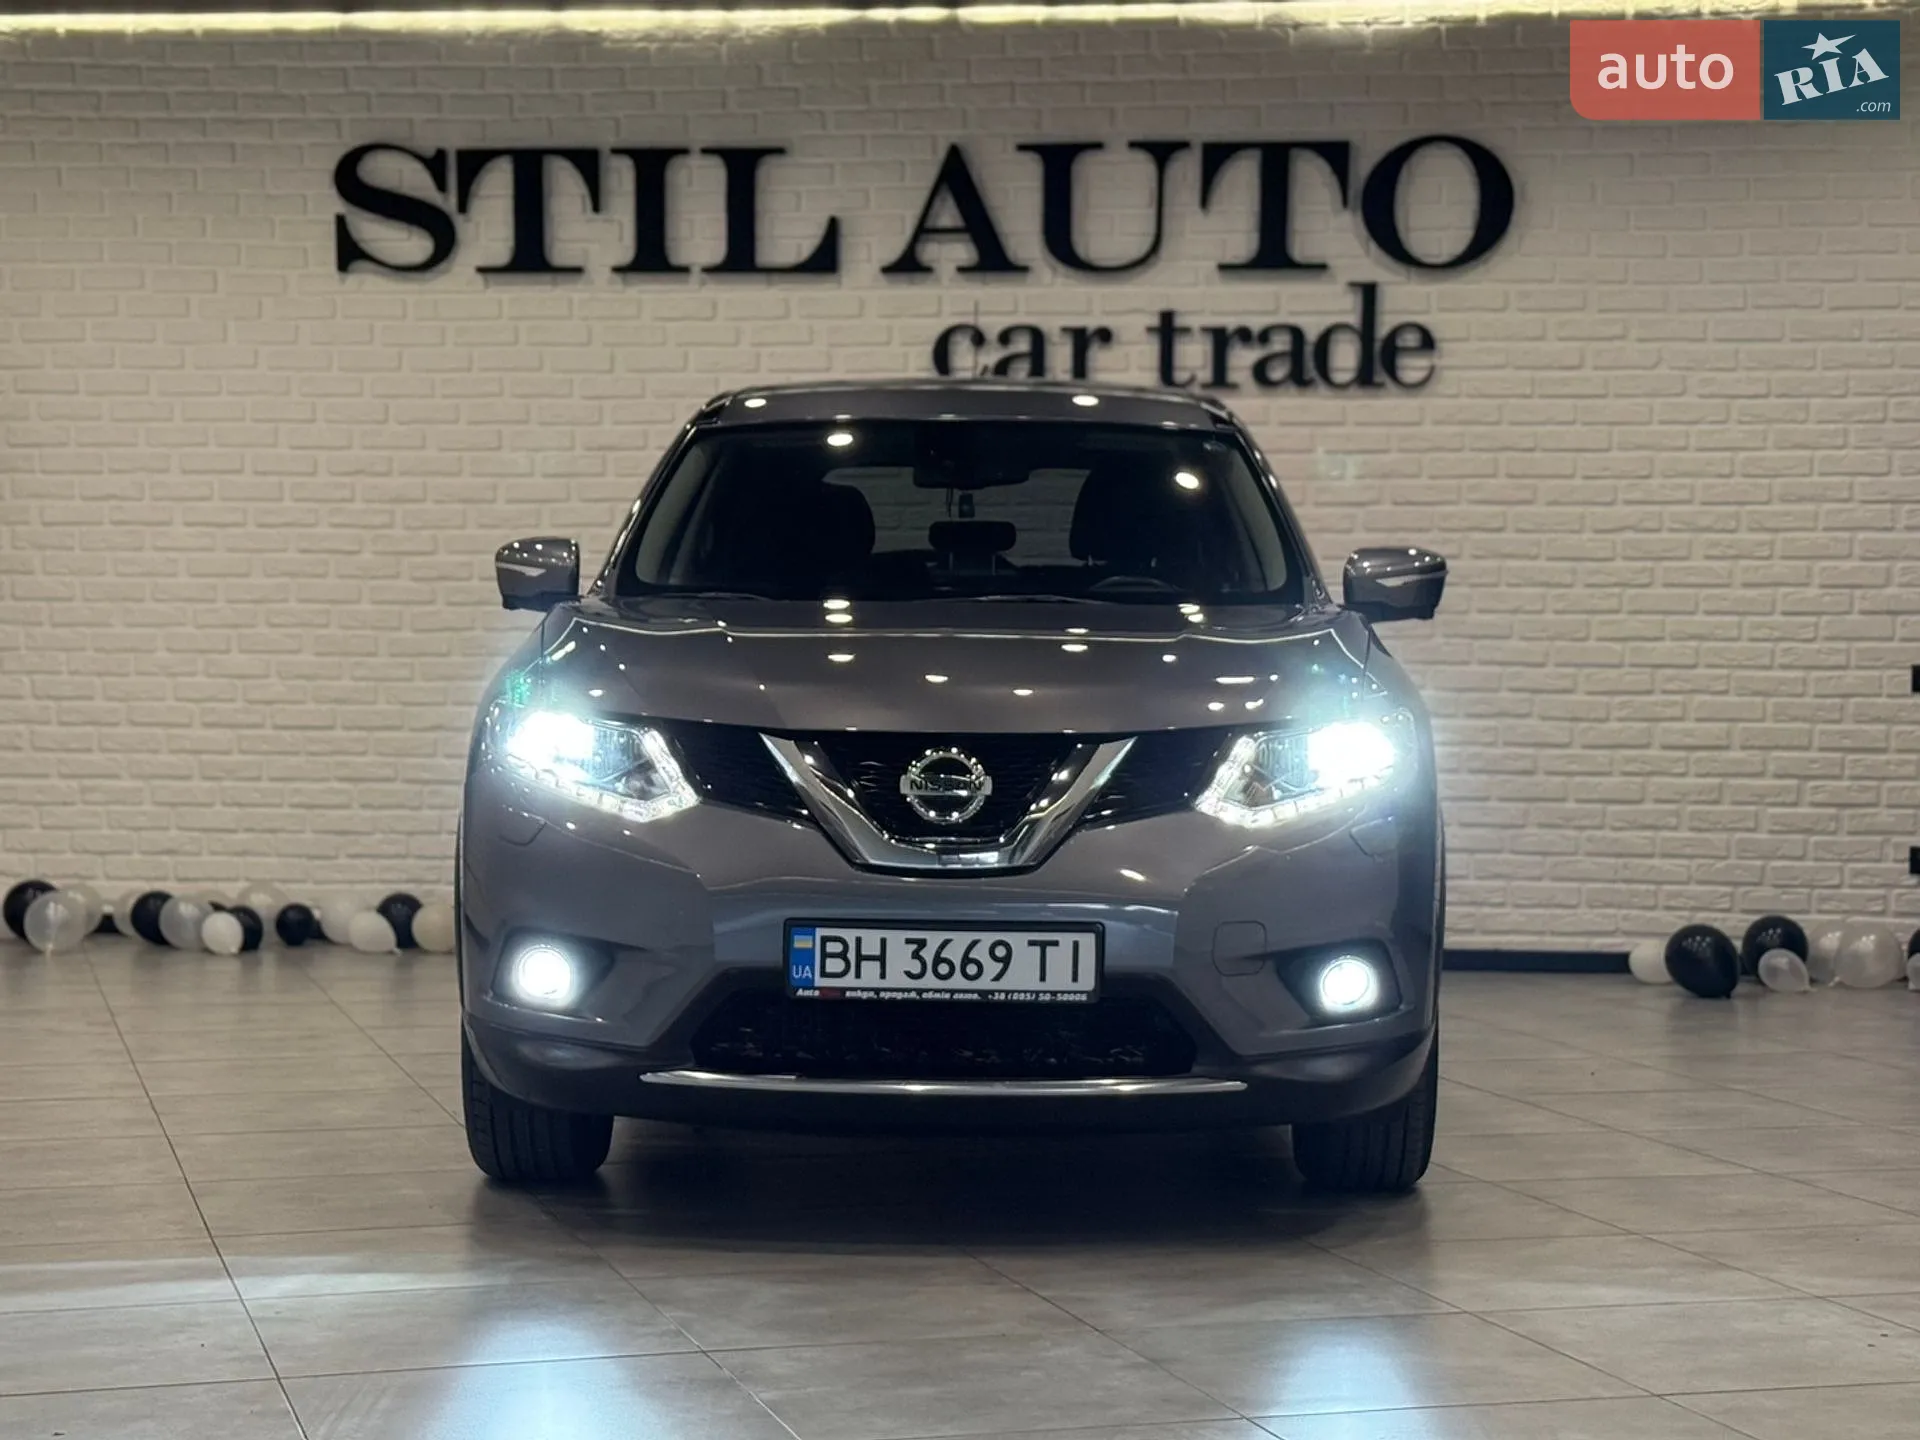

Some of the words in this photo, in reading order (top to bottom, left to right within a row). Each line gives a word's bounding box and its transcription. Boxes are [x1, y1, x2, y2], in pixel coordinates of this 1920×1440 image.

[333, 143, 840, 274] STIL
[880, 134, 1515, 274] AUTO
[932, 321, 1113, 379] car
[1146, 281, 1436, 390] trade
[792, 964, 813, 979] UA
[819, 935, 887, 980] BH
[903, 938, 1013, 982] 3669
[1027, 939, 1080, 983] TI
